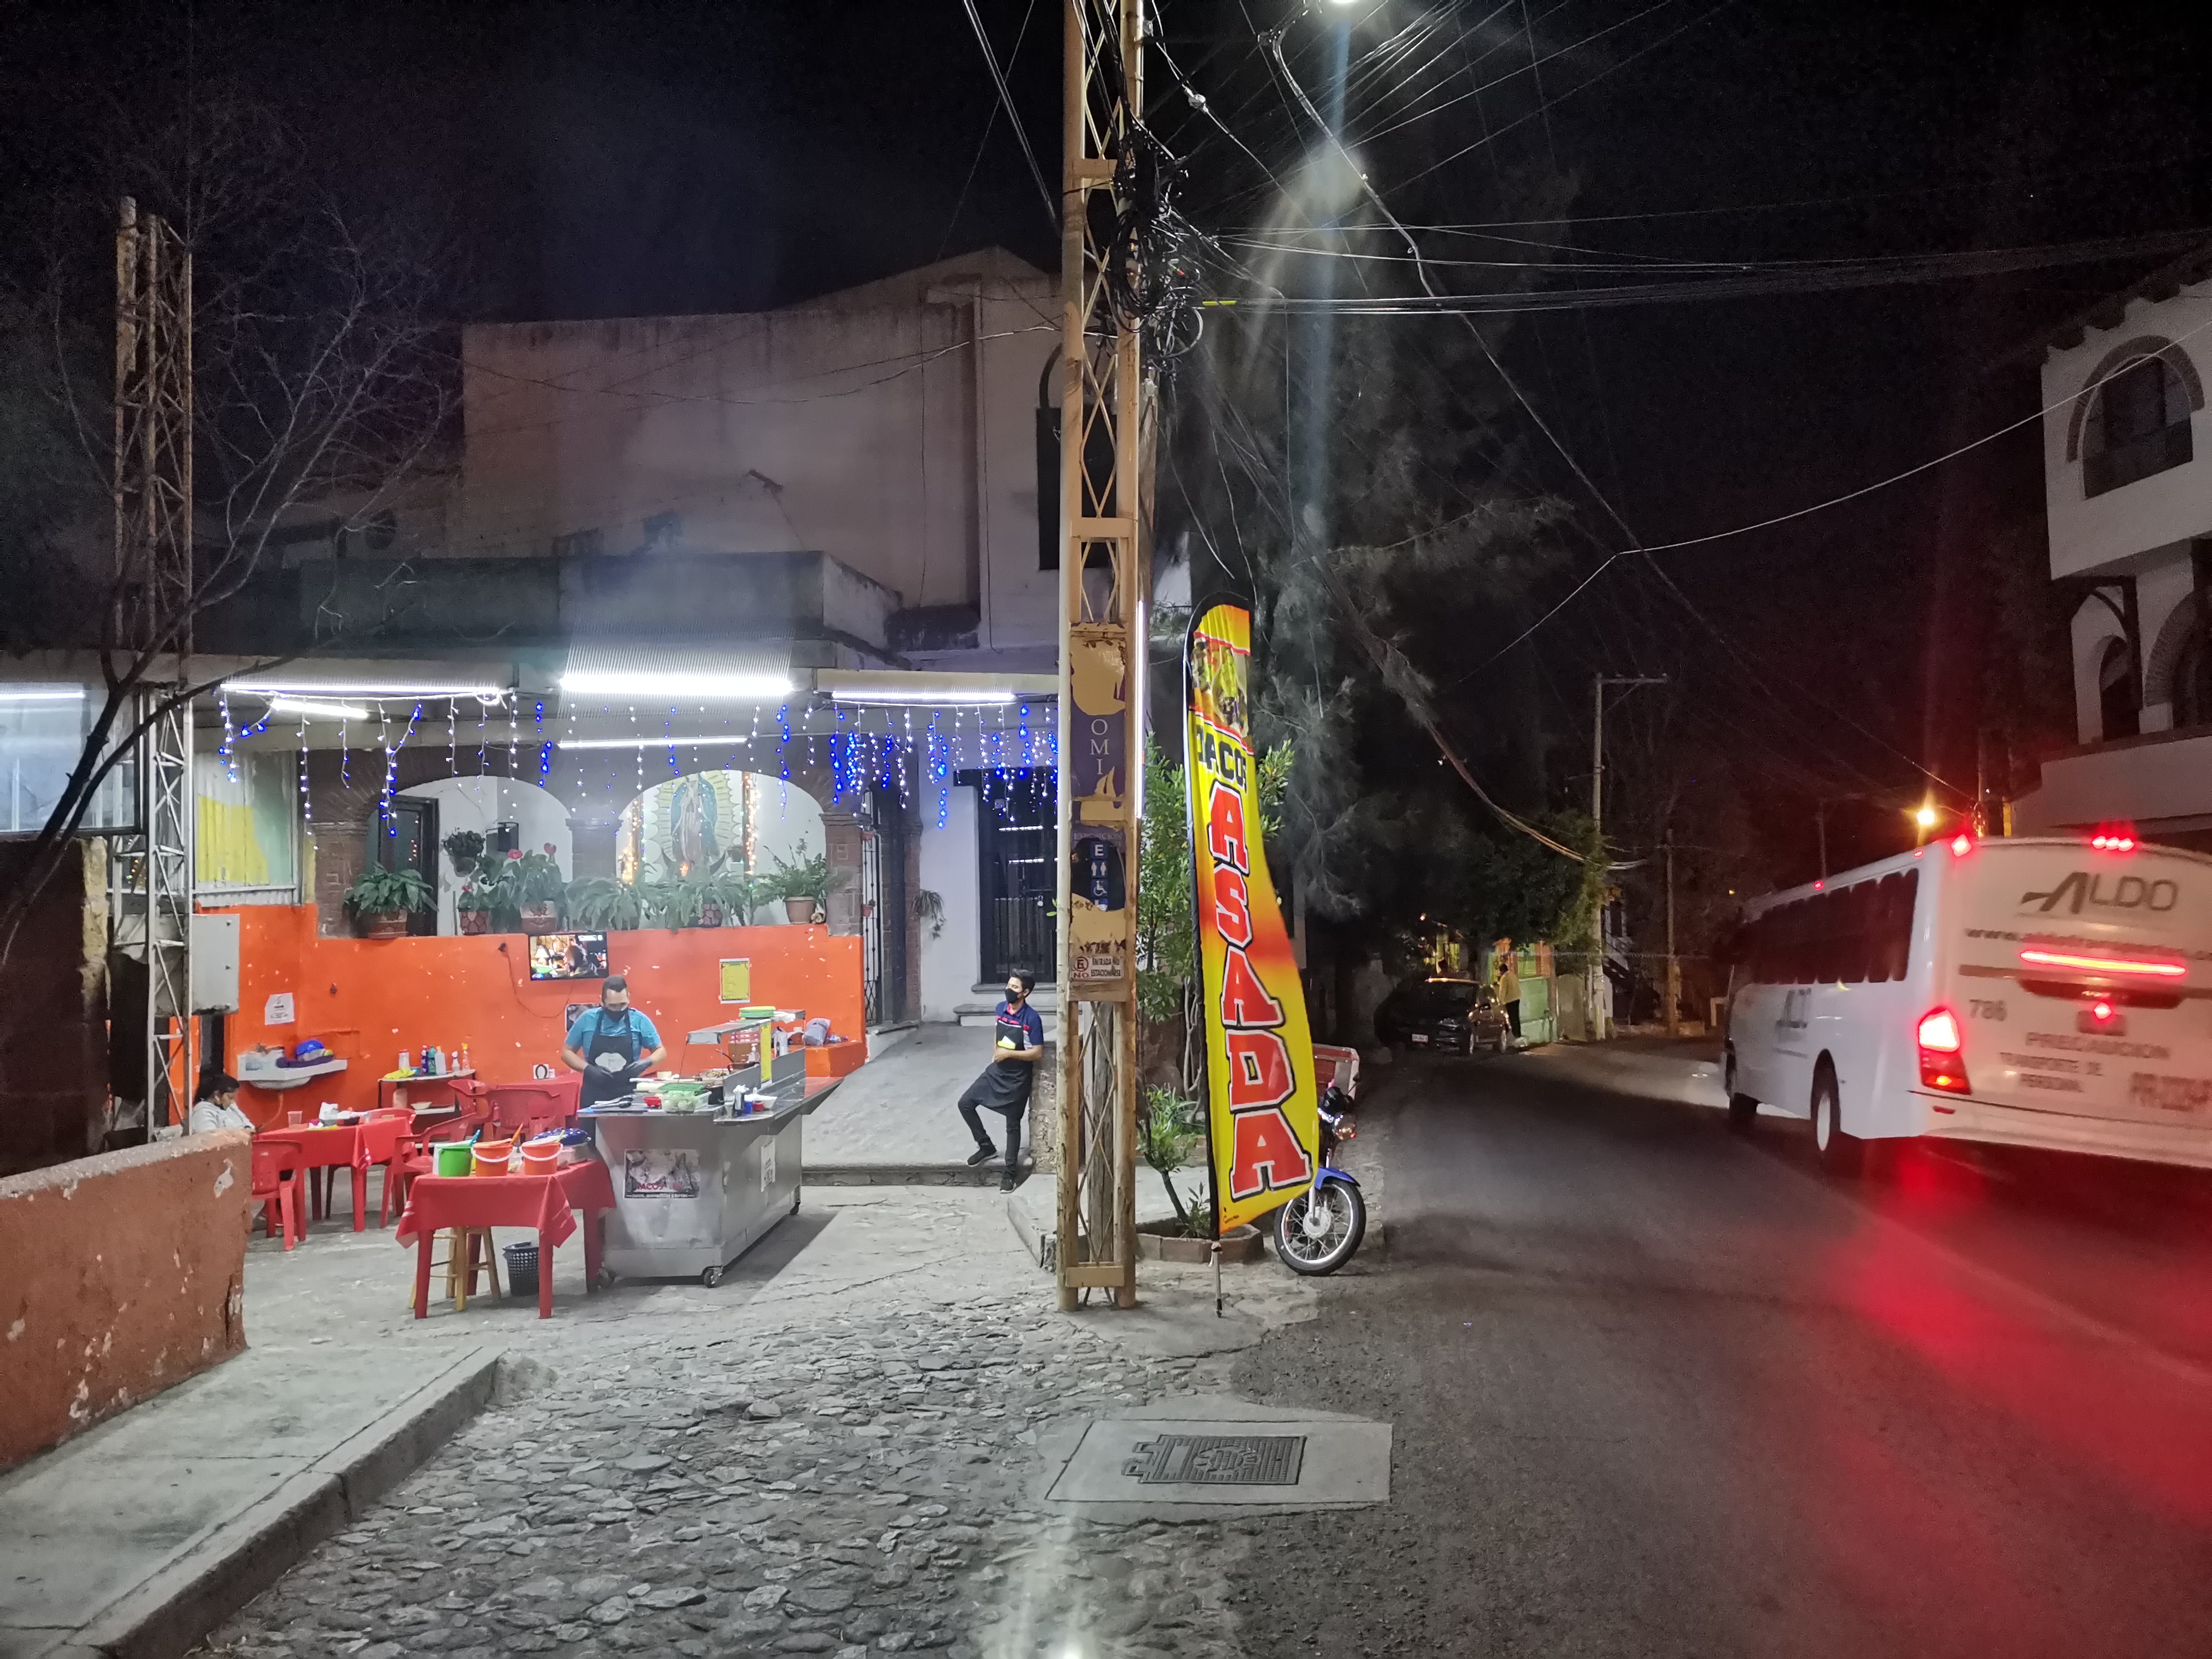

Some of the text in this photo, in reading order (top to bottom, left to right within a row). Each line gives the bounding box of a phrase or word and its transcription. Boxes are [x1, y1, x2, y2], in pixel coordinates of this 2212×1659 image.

[1095, 844, 1104, 856] E
[2021, 872, 2179, 914] ALDO
[1208, 779, 1313, 1203] ASADA
